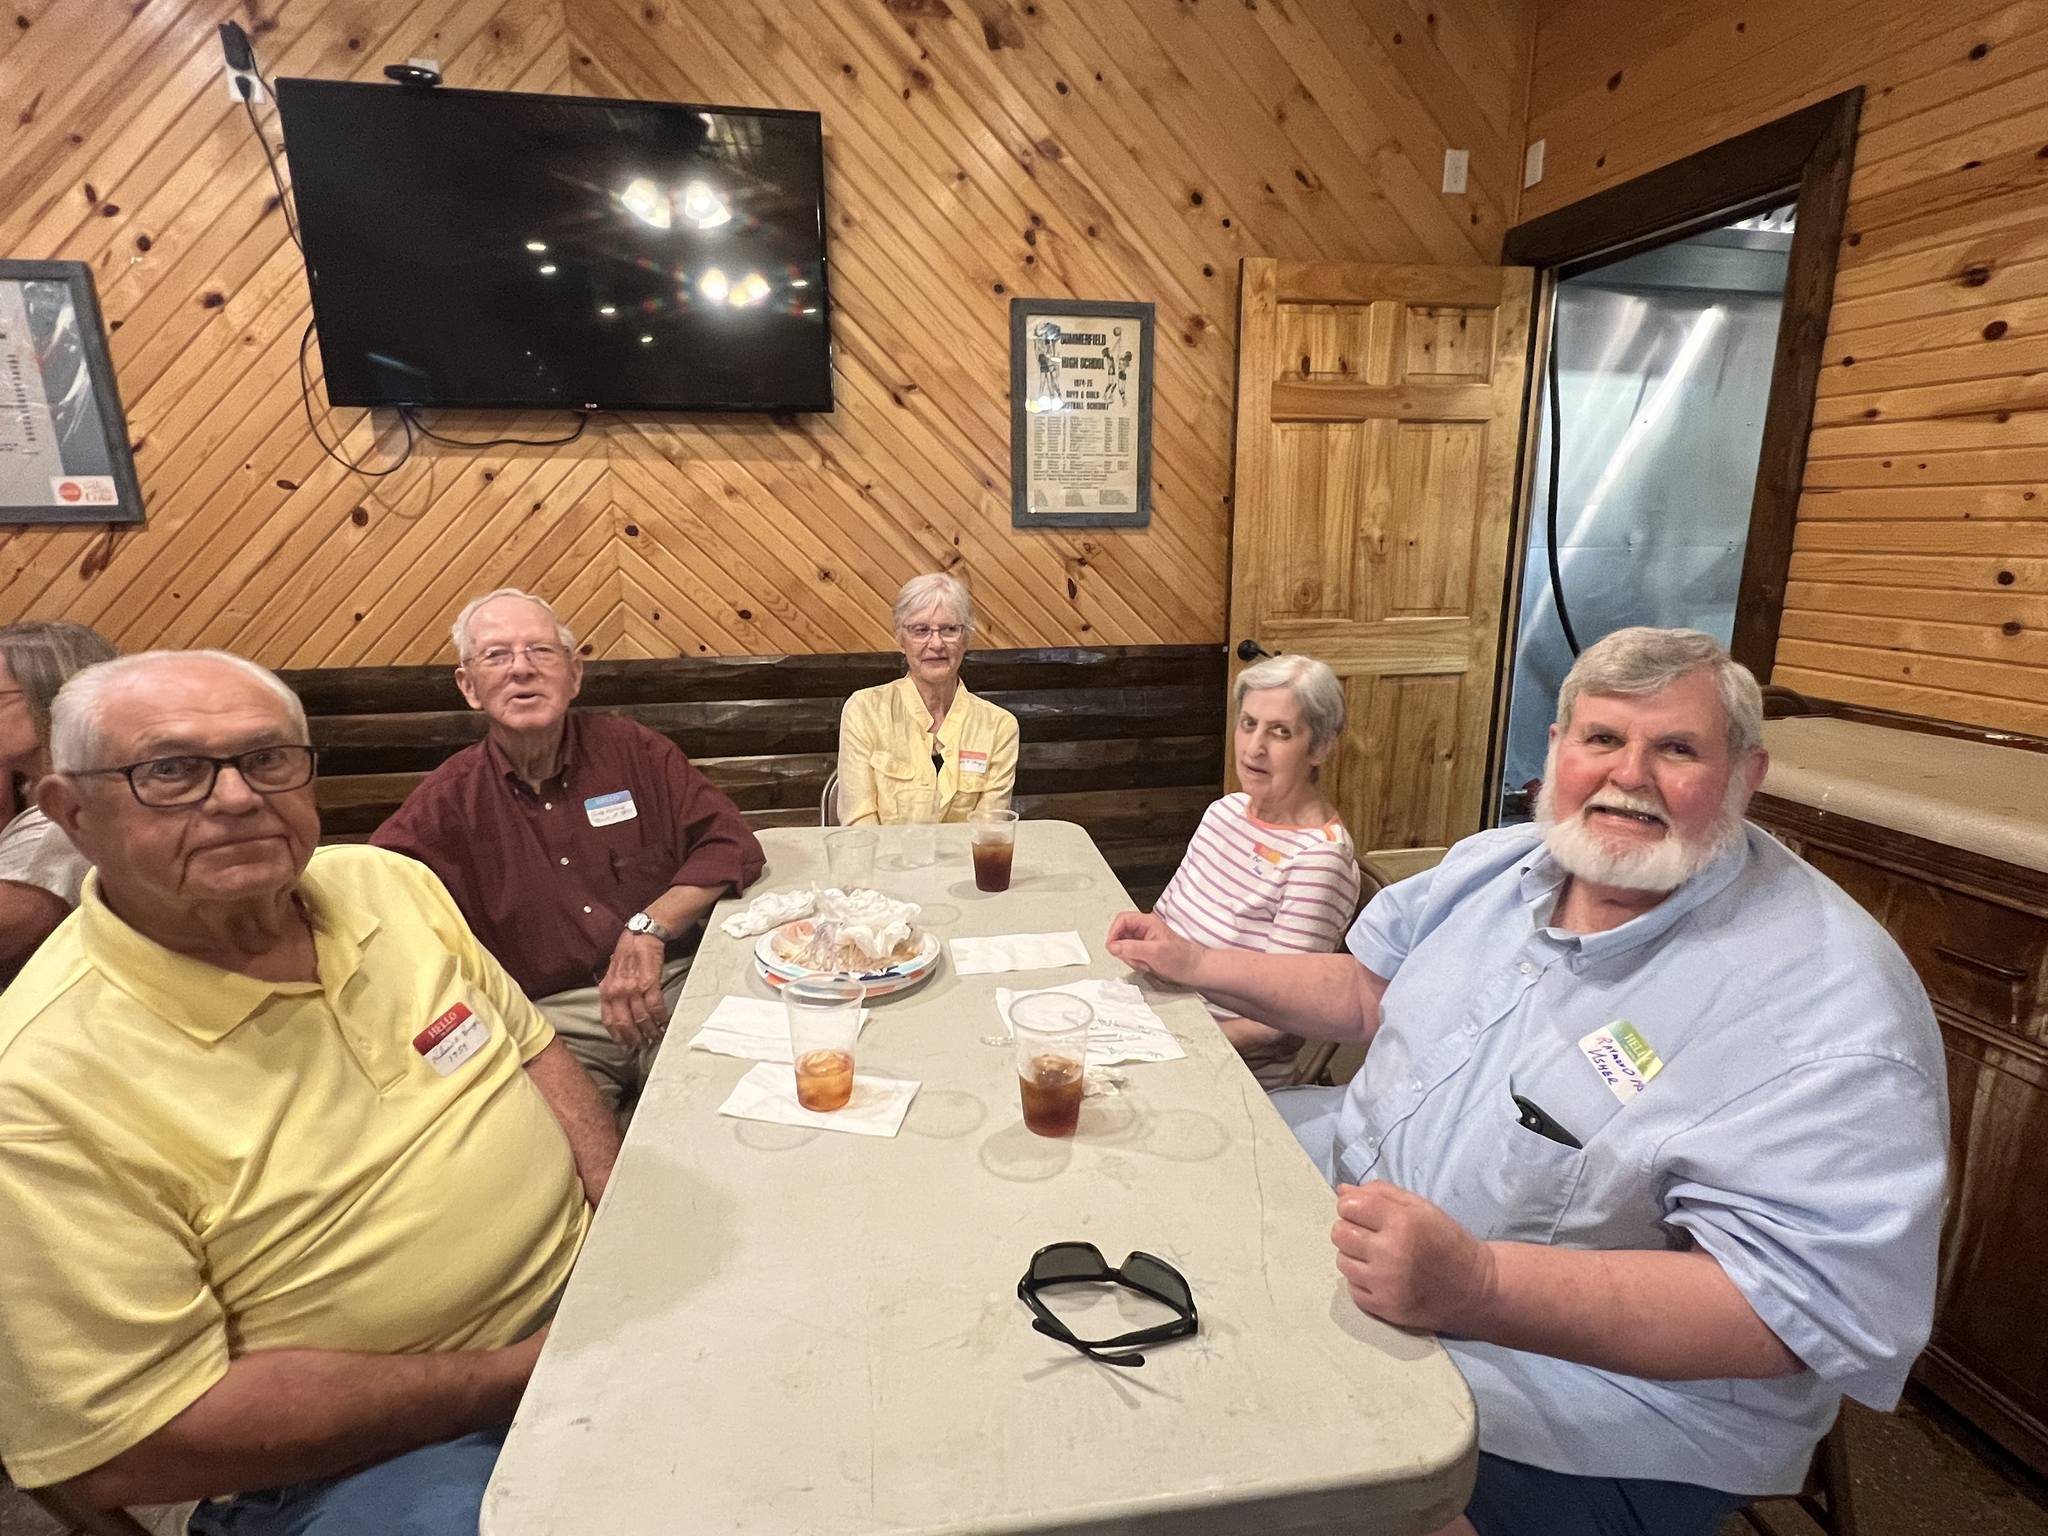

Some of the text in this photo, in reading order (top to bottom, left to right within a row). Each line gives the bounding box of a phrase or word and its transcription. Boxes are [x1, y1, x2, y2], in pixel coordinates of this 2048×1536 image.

[1060, 333, 1107, 346] SUMMERFIELD
[1061, 357, 1105, 370] HIGH SCHOOL
[1066, 390, 1079, 399] BOYS
[1086, 391, 1100, 399] GIRLS
[427, 1011, 457, 1039] HELLO
[1597, 1036, 1636, 1077] RAYMOND
